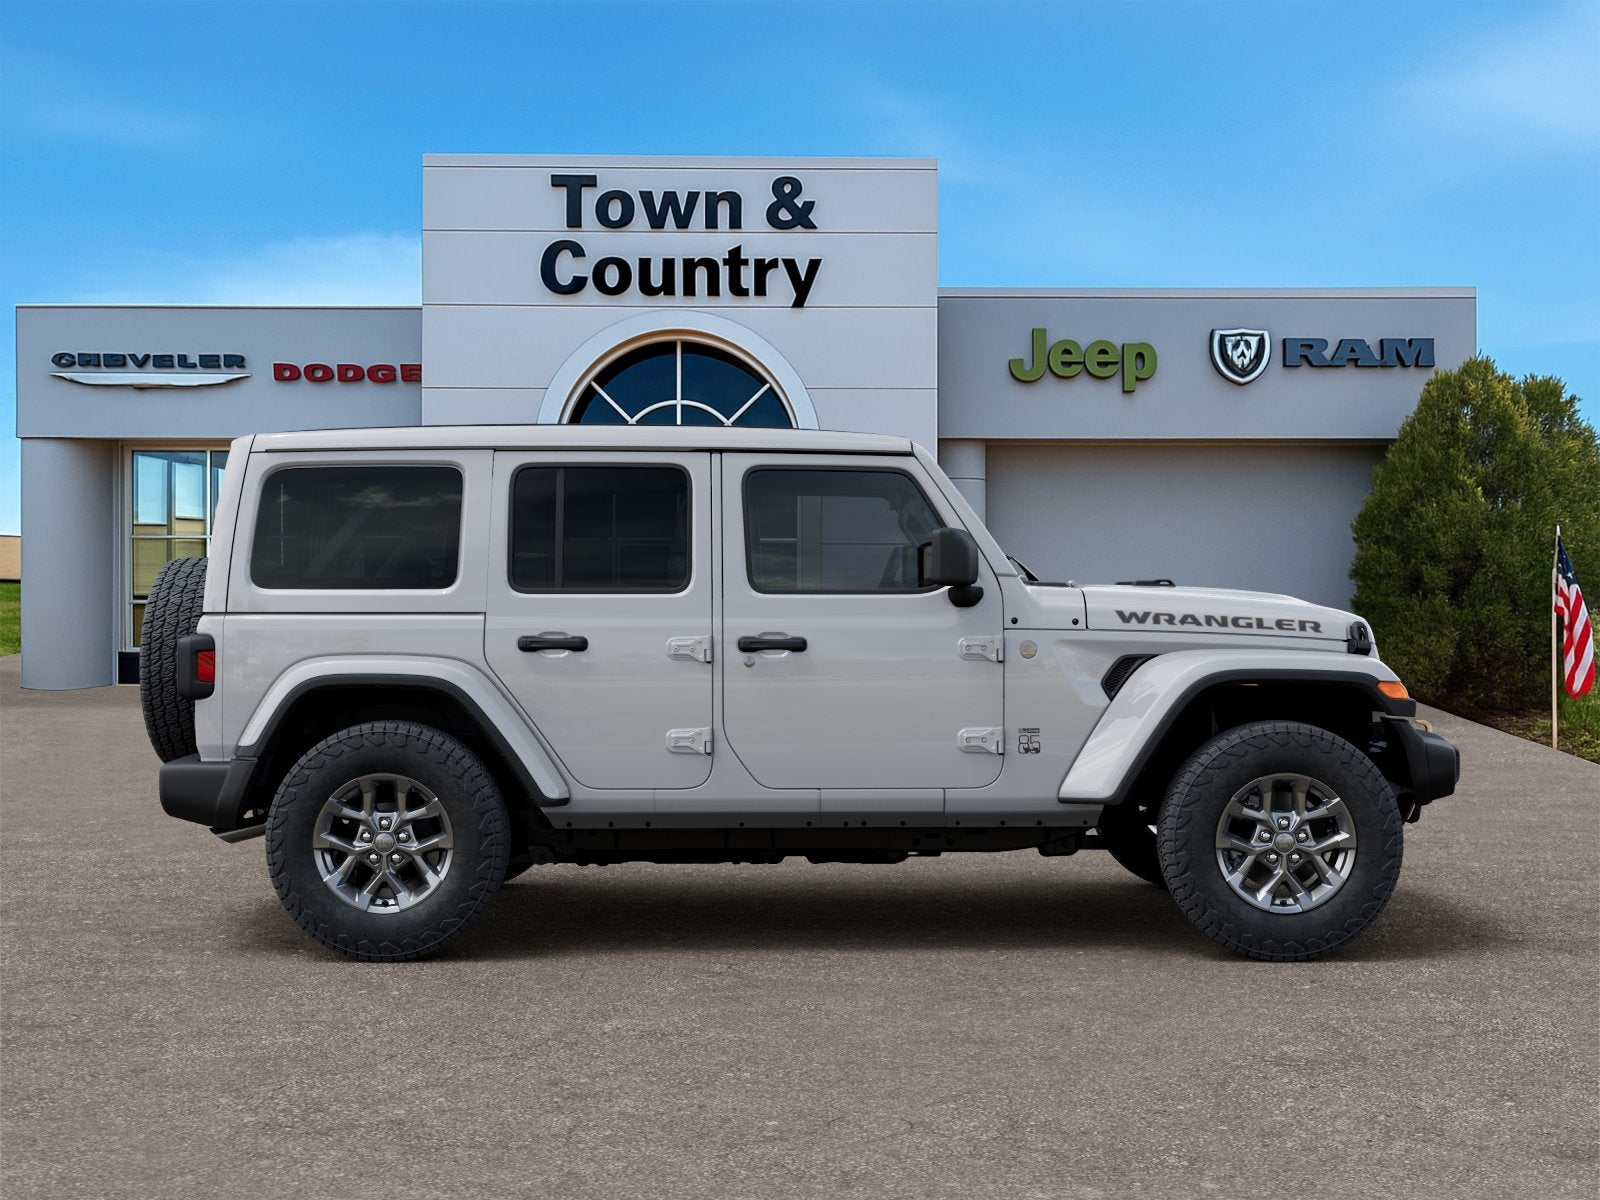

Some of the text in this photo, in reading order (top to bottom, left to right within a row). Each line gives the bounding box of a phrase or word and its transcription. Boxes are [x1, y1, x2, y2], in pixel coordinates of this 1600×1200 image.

[550, 174, 818, 230] Town &
[539, 239, 822, 308] Country
[273, 363, 422, 383] DODGE
[1009, 328, 1157, 393] Jeep
[1282, 337, 1436, 368] RAM
[1114, 609, 1323, 633] WRANGLER
